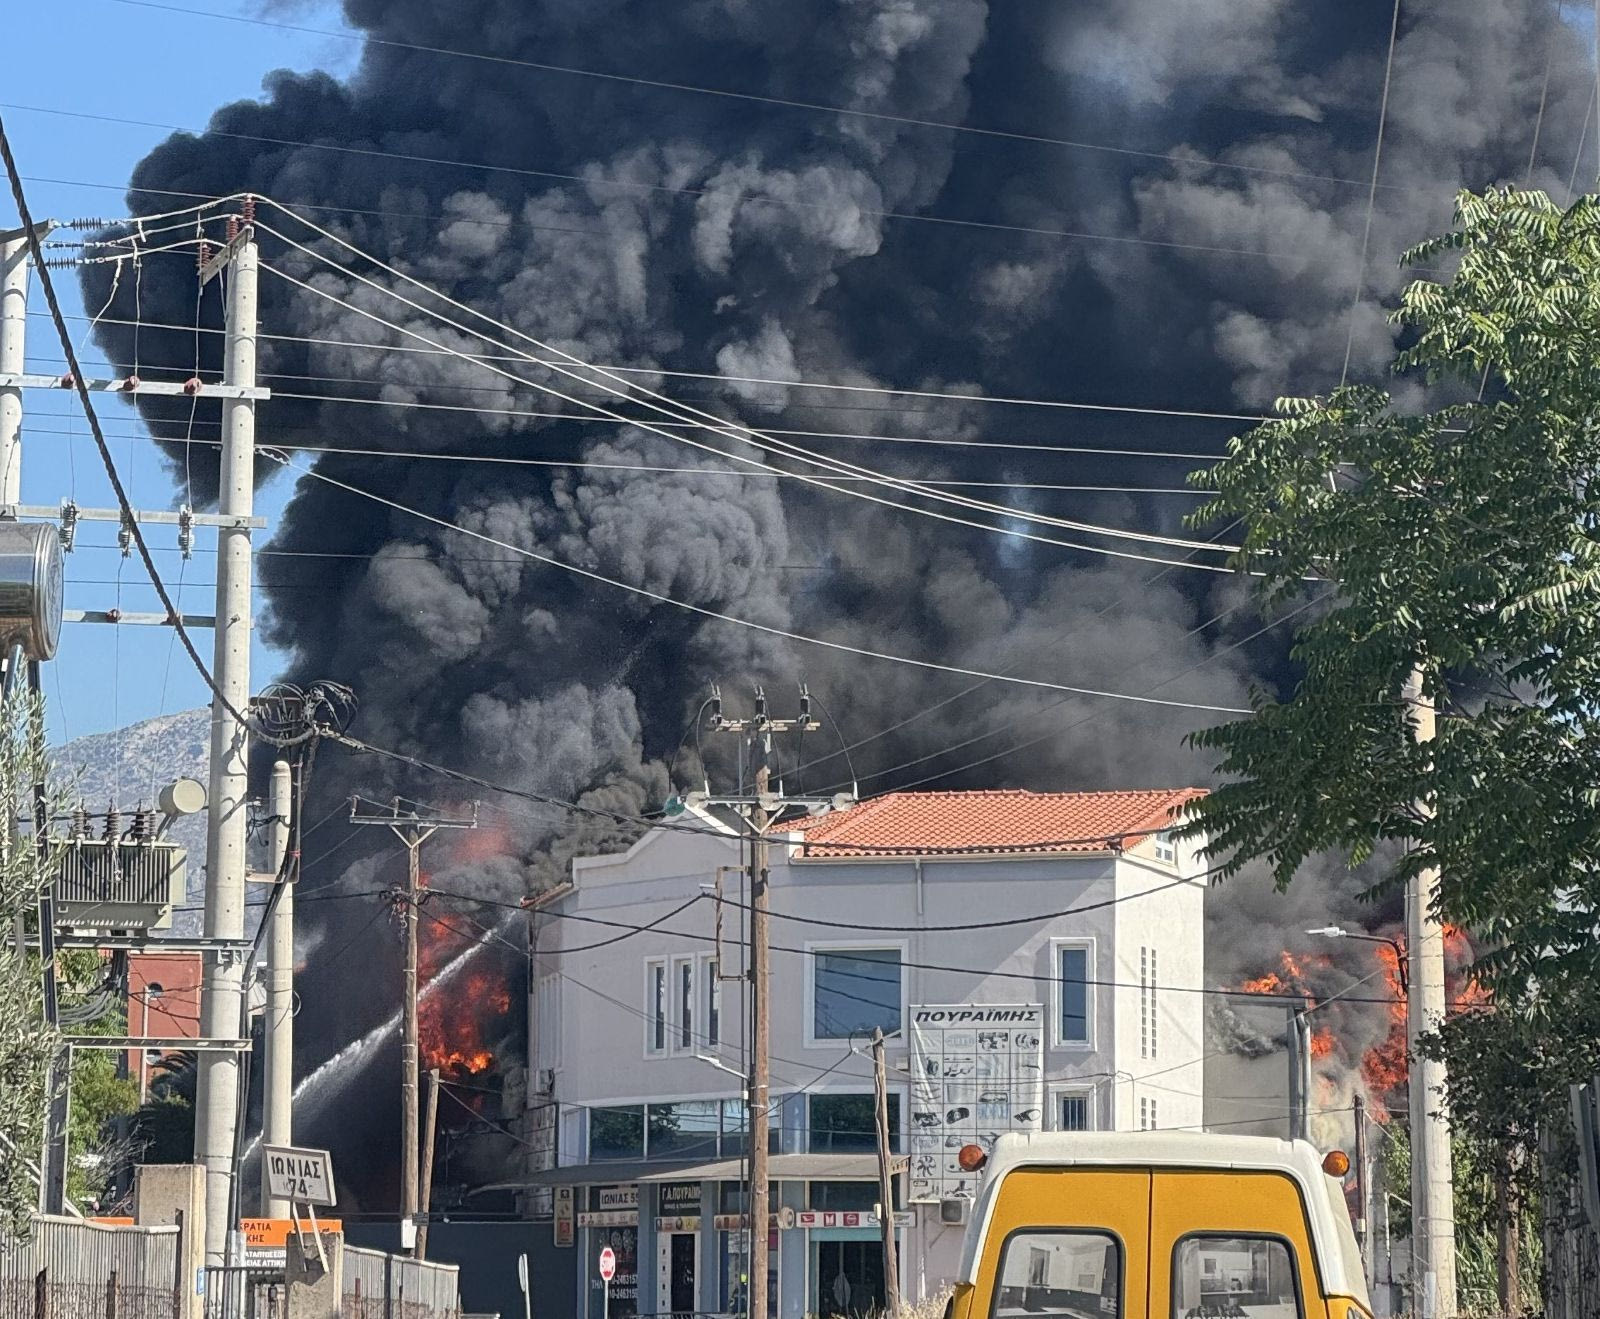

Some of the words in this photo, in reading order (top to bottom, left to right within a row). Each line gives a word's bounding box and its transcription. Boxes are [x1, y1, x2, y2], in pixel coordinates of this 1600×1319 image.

[915, 1008, 1040, 1022] ΠΟΥΡΑΪΜΗΣ
[271, 1156, 321, 1179] ΙΩΝΙΑΣ
[287, 1178, 308, 1197] 74
[601, 1192, 629, 1205] ΙΩΝΙΑΣ
